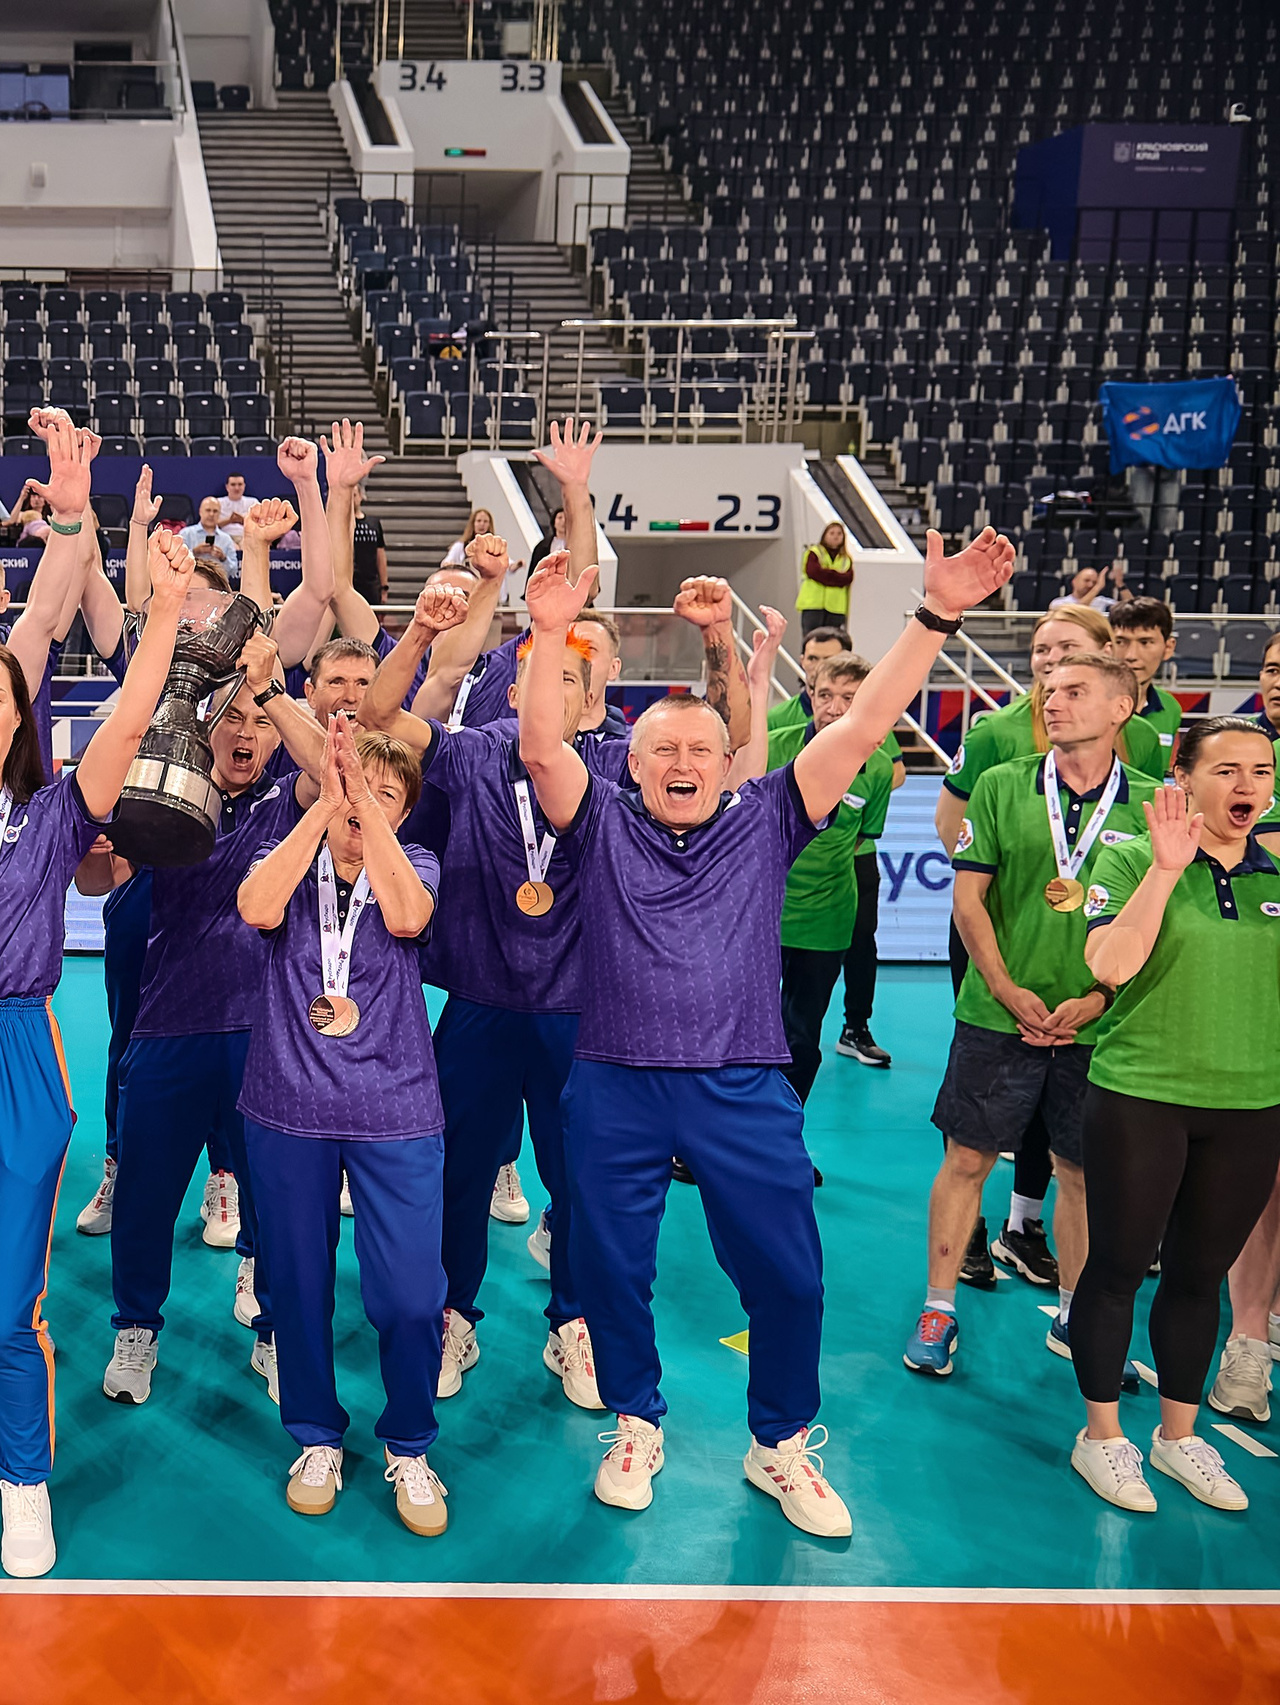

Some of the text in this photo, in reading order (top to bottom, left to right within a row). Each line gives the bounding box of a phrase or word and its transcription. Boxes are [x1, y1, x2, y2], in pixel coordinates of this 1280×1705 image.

[399, 62, 546, 91] 3.4 3.3
[1162, 410, 1207, 435] ДГК
[589, 493, 782, 531] .4 2.3
